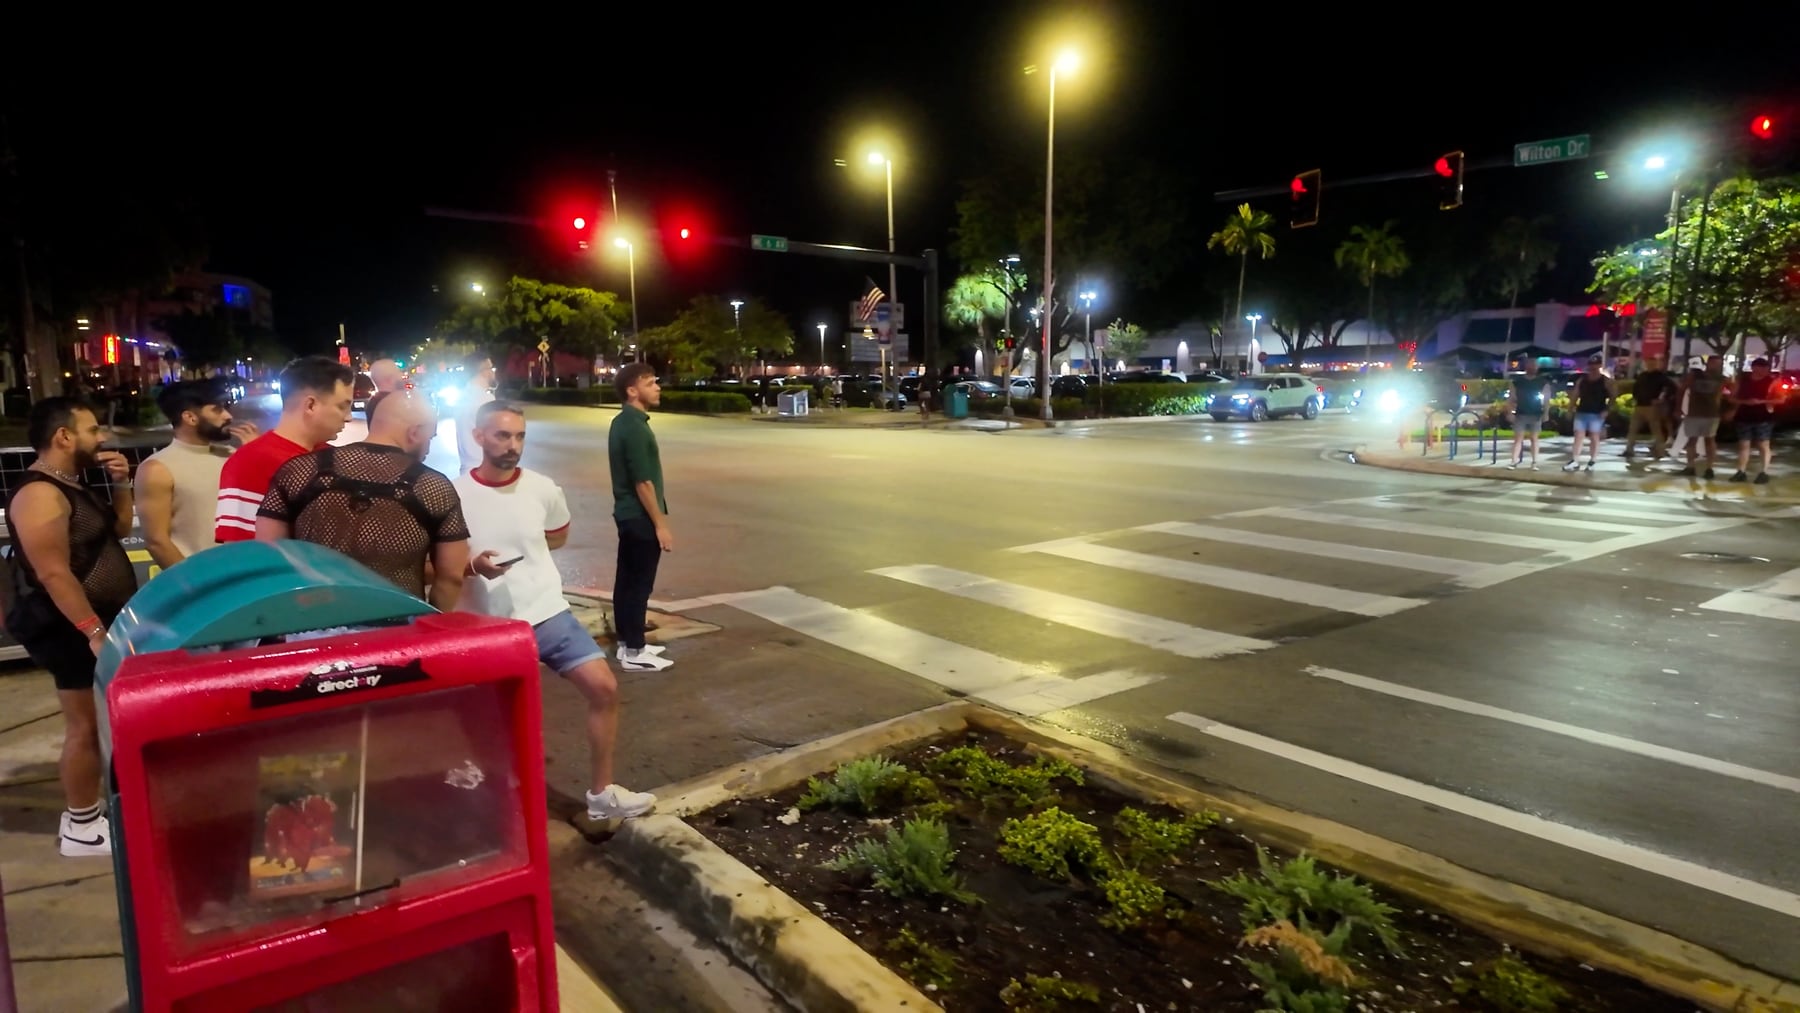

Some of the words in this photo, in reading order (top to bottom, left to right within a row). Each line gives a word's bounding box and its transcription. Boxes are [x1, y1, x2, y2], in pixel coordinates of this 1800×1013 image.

[1519, 145, 1561, 162] Wilton
[1567, 140, 1584, 156] Dr
[317, 675, 381, 693] directory
